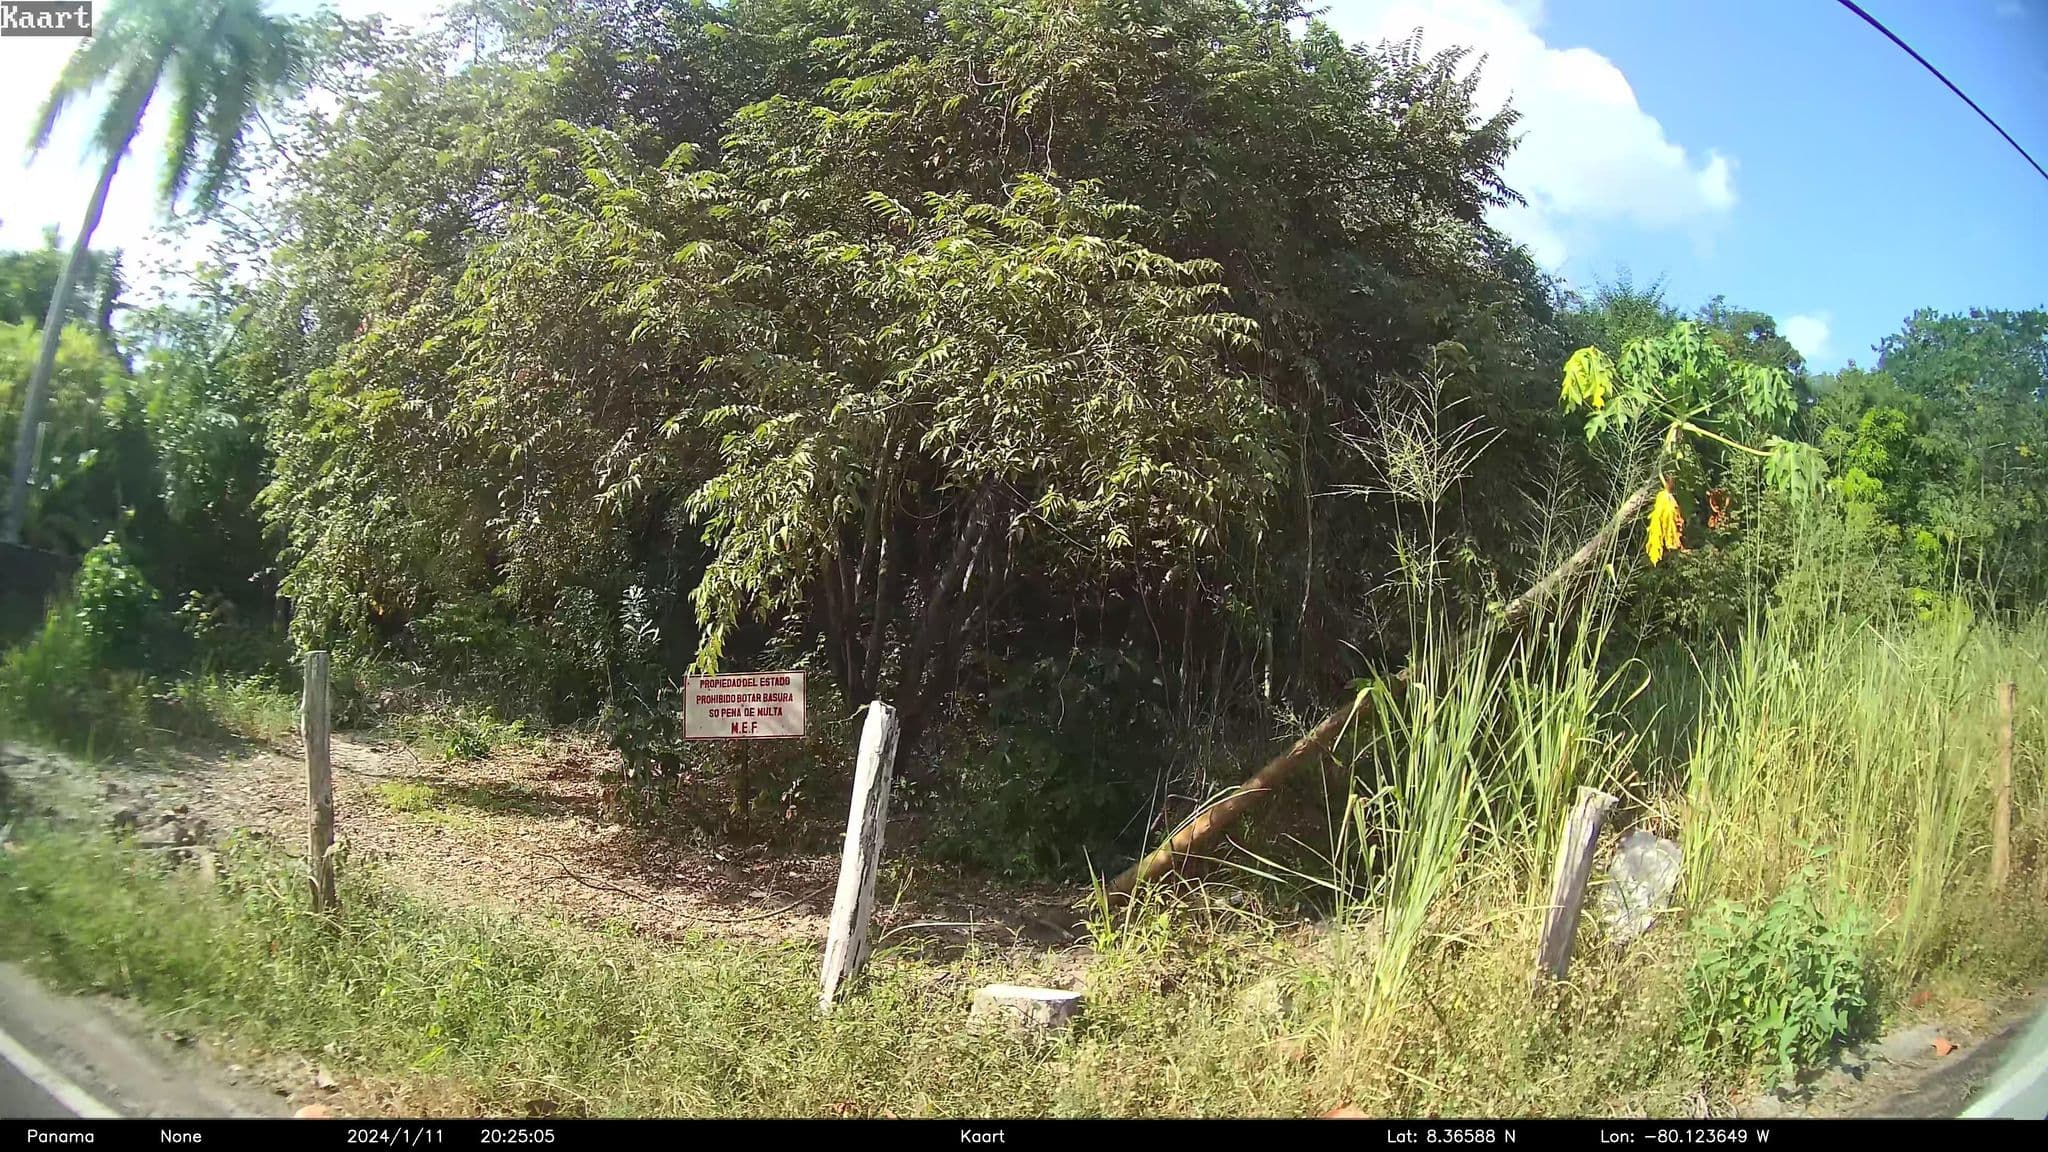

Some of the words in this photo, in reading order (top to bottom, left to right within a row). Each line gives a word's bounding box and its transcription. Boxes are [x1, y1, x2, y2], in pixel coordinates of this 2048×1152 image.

[700, 679, 741, 688] PROPIEDAD
[742, 678, 758, 687] DEL
[760, 677, 790, 686] ESTADO
[696, 694, 735, 704] PROHIBIDO
[737, 693, 761, 703] BOTAR
[763, 693, 793, 702] BASURA
[709, 709, 719, 718] SO
[721, 708, 741, 717] PENA
[744, 708, 755, 716] DE
[757, 707, 783, 716] MULTA
